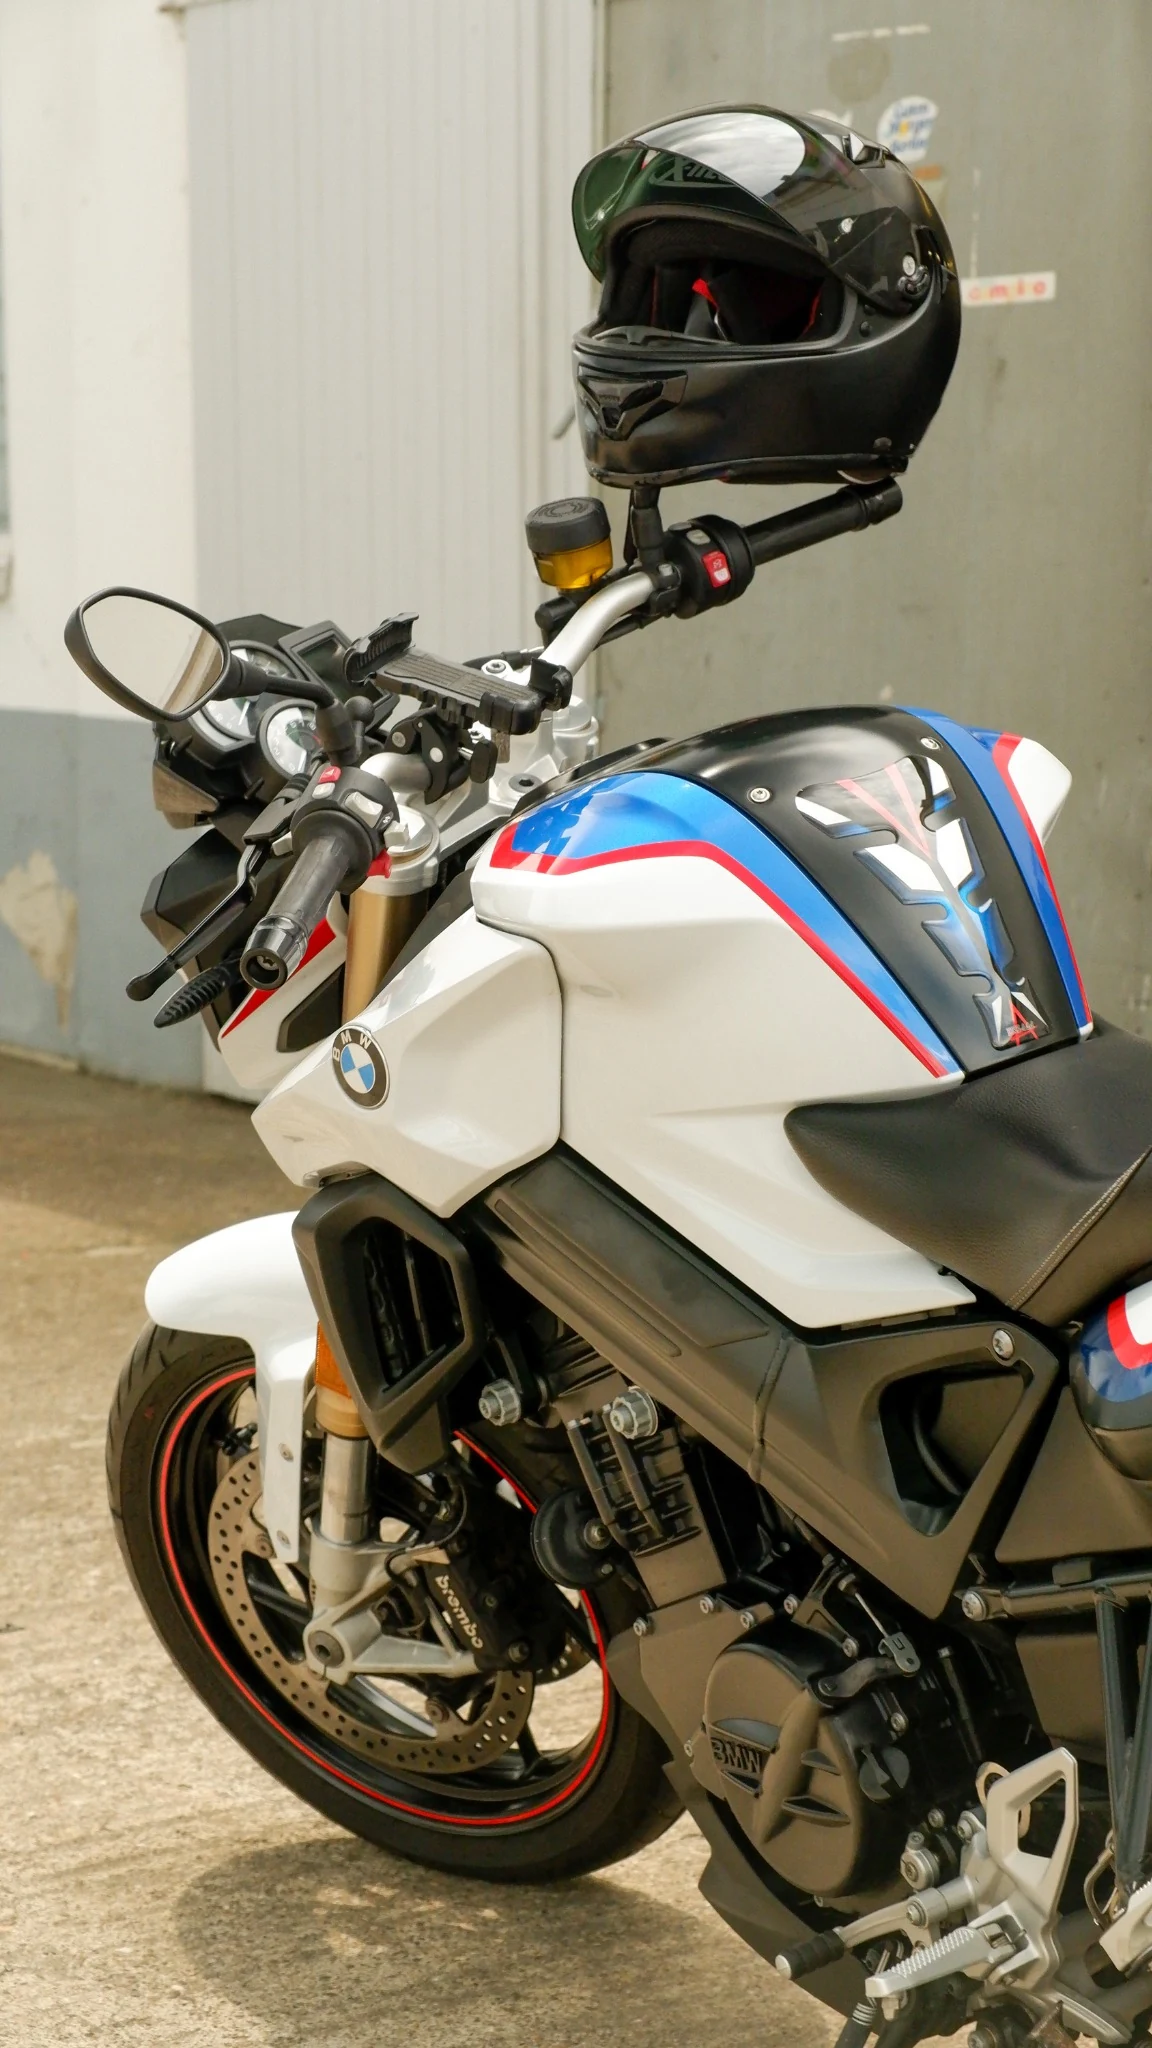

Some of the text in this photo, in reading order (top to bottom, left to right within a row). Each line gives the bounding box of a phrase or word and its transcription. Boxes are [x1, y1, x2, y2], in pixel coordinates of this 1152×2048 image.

[332, 1029, 372, 1062] BMW
[435, 1574, 484, 1649] brembo
[709, 1737, 762, 1774] BMW
